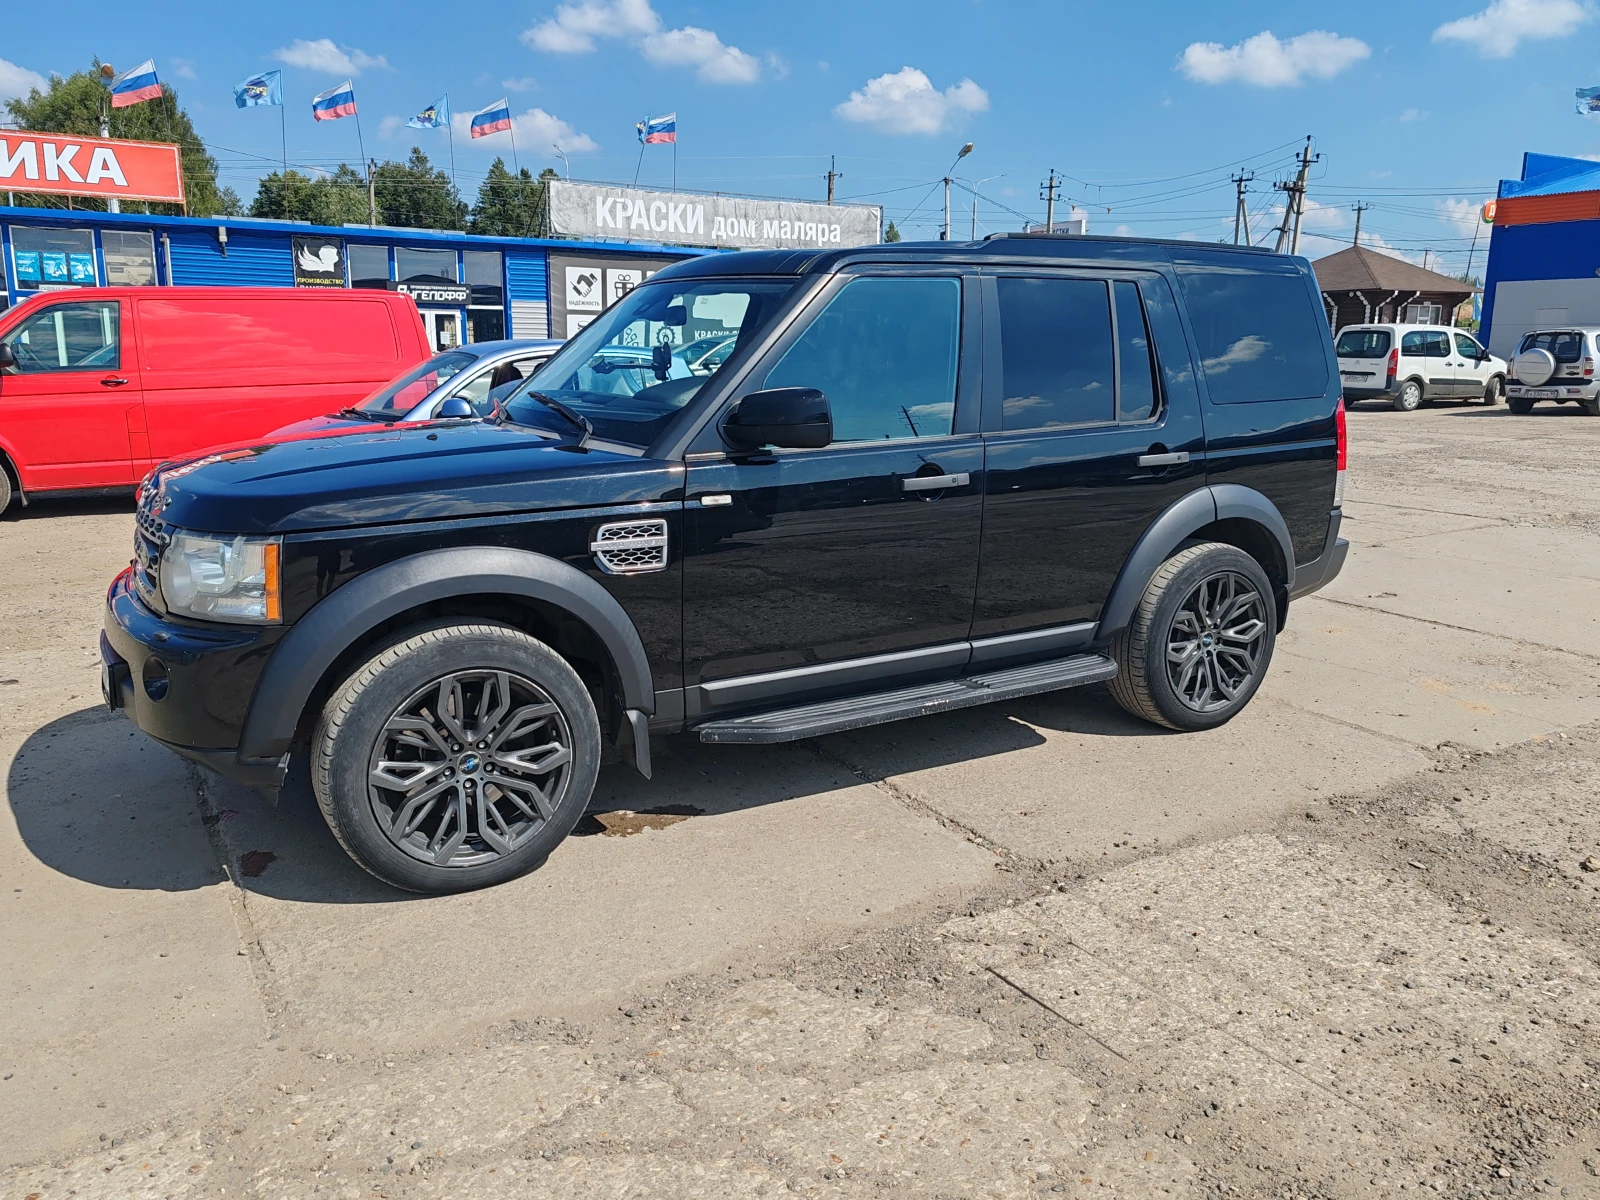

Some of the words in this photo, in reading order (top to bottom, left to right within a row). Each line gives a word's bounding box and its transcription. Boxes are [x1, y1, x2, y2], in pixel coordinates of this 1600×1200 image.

[0, 139, 129, 187] ИКА
[596, 196, 704, 235] КРАСКИ
[711, 216, 756, 240] дом
[763, 219, 841, 247] маляра
[296, 277, 344, 285] ПРОИЗВОДСТВО
